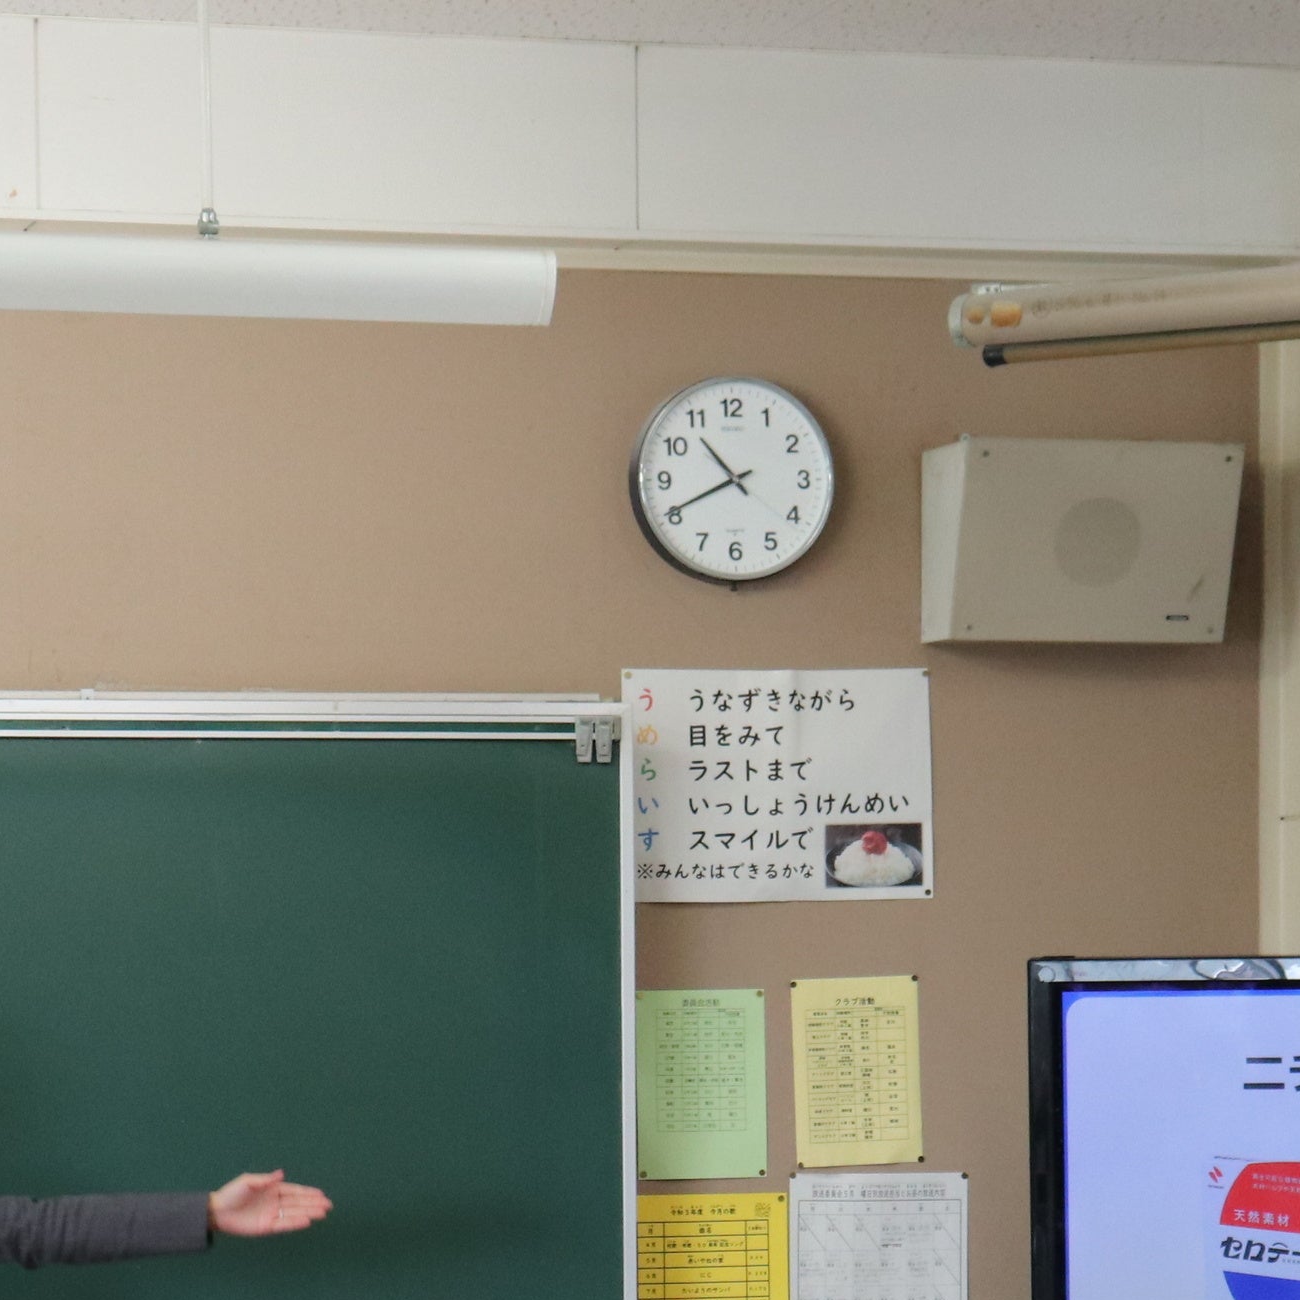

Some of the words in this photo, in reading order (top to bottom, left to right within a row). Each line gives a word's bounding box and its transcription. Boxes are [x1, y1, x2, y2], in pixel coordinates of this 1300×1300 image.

[720, 399, 743, 417] 12
[761, 408, 770, 427] 1
[686, 409, 705, 428] 11
[663, 437, 688, 456] 10
[786, 434, 799, 453] 2
[657, 471, 672, 490] 9
[797, 470, 810, 489] 3
[786, 506, 800, 524] 4
[696, 533, 709, 551] 7
[765, 532, 778, 550] 5
[729, 542, 743, 561] 6
[639, 688, 654, 712] う
[689, 688, 855, 712] うなずきながら
[636, 726, 657, 745] め
[690, 724, 784, 747] 目をみて
[640, 759, 657, 782] ら
[688, 757, 812, 782] ラストまで
[638, 797, 659, 815] い
[689, 794, 909, 816] いっしょうけんめい
[638, 828, 659, 851] す
[689, 826, 814, 851] スマイルで
[835, 997, 875, 1006] クラブ活動
[1234, 1209, 1291, 1227] 天然素材
